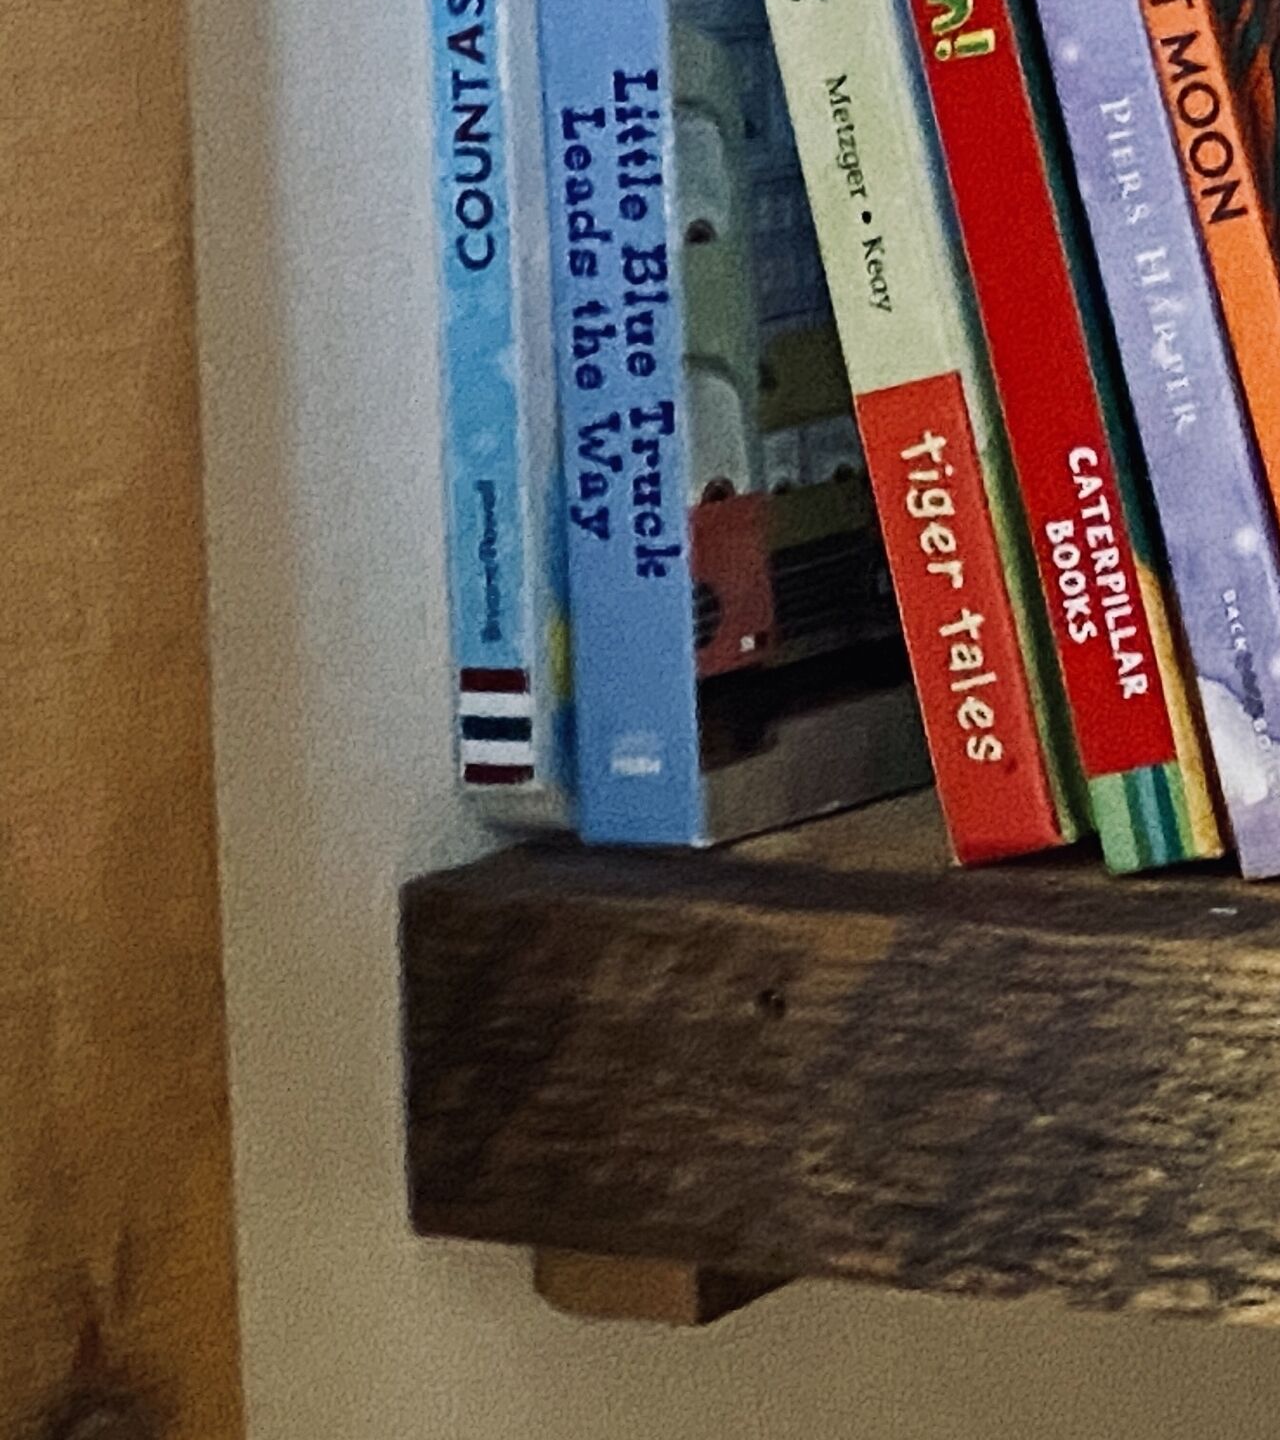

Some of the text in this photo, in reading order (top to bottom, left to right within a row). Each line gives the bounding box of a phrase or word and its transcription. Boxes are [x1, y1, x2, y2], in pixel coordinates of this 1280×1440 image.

[826, 74, 867, 198] Metzger
[1100, 97, 1150, 226] PIERS
[1160, 31, 1249, 224] MOON
[562, 107, 624, 542] Leads the Way
[613, 70, 682, 579] Little Blue Truck
[900, 429, 1004, 764] tiger tales
[1045, 519, 1100, 646] BOOKS
[1067, 446, 1151, 700] CATERPILLAR
